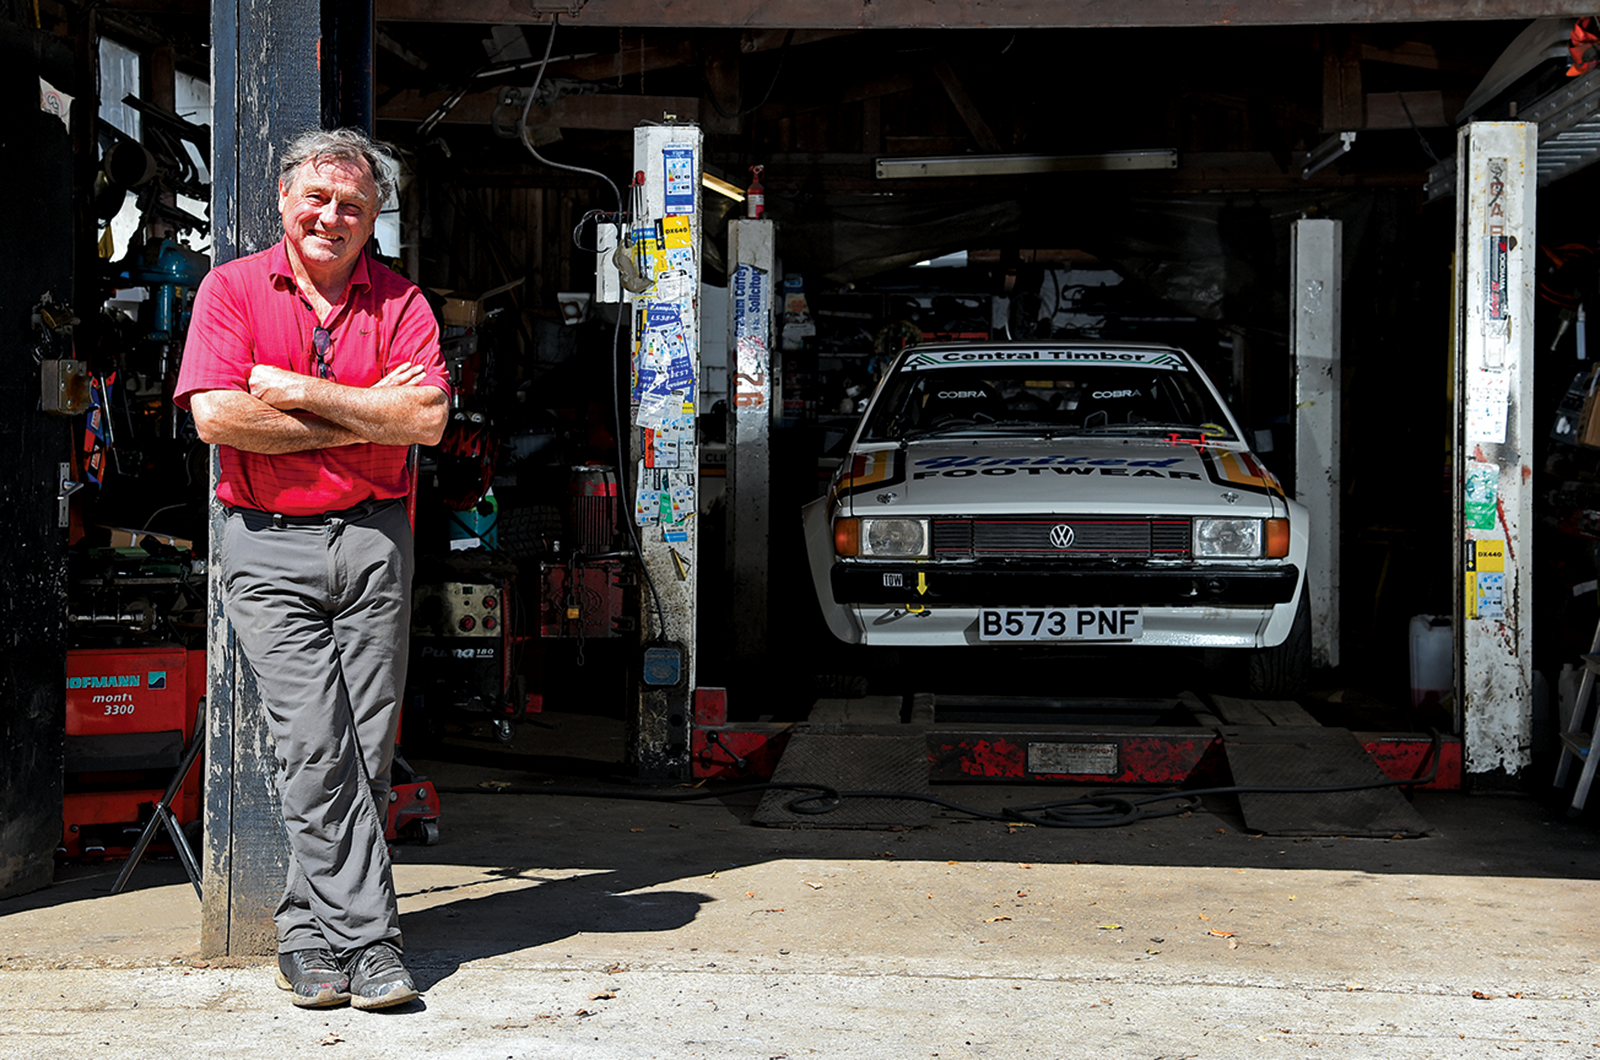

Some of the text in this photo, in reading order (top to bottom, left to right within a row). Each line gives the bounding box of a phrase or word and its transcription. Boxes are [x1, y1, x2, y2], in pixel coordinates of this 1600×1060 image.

[665, 227, 688, 235] DX640
[733, 266, 749, 337] Graham Coffey
[942, 351, 1146, 362] Central Timber
[937, 390, 988, 399] COBRA
[1092, 389, 1142, 399] COBRA
[913, 455, 1185, 469] United
[912, 467, 1203, 482] FOOTWEAR
[884, 574, 902, 586] TOW
[983, 610, 1139, 636] B573 PNF
[66, 675, 140, 689] OFMANN
[103, 704, 135, 716] 3300
